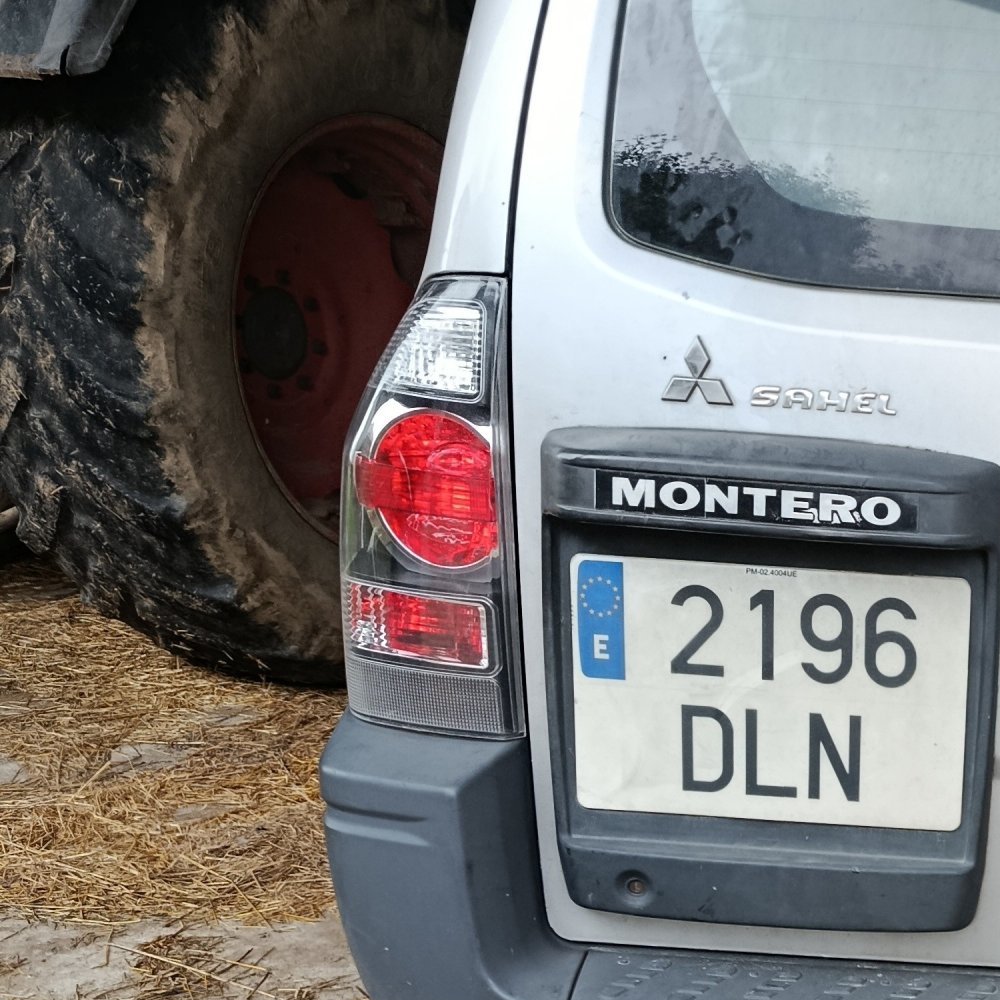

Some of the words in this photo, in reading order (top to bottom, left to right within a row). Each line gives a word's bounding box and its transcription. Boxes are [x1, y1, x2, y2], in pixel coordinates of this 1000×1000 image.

[750, 385, 897, 416] SAHEL
[611, 476, 902, 527] MONTERO
[593, 633, 610, 660] E
[670, 584, 917, 688] 2196
[681, 704, 862, 802] DLN
